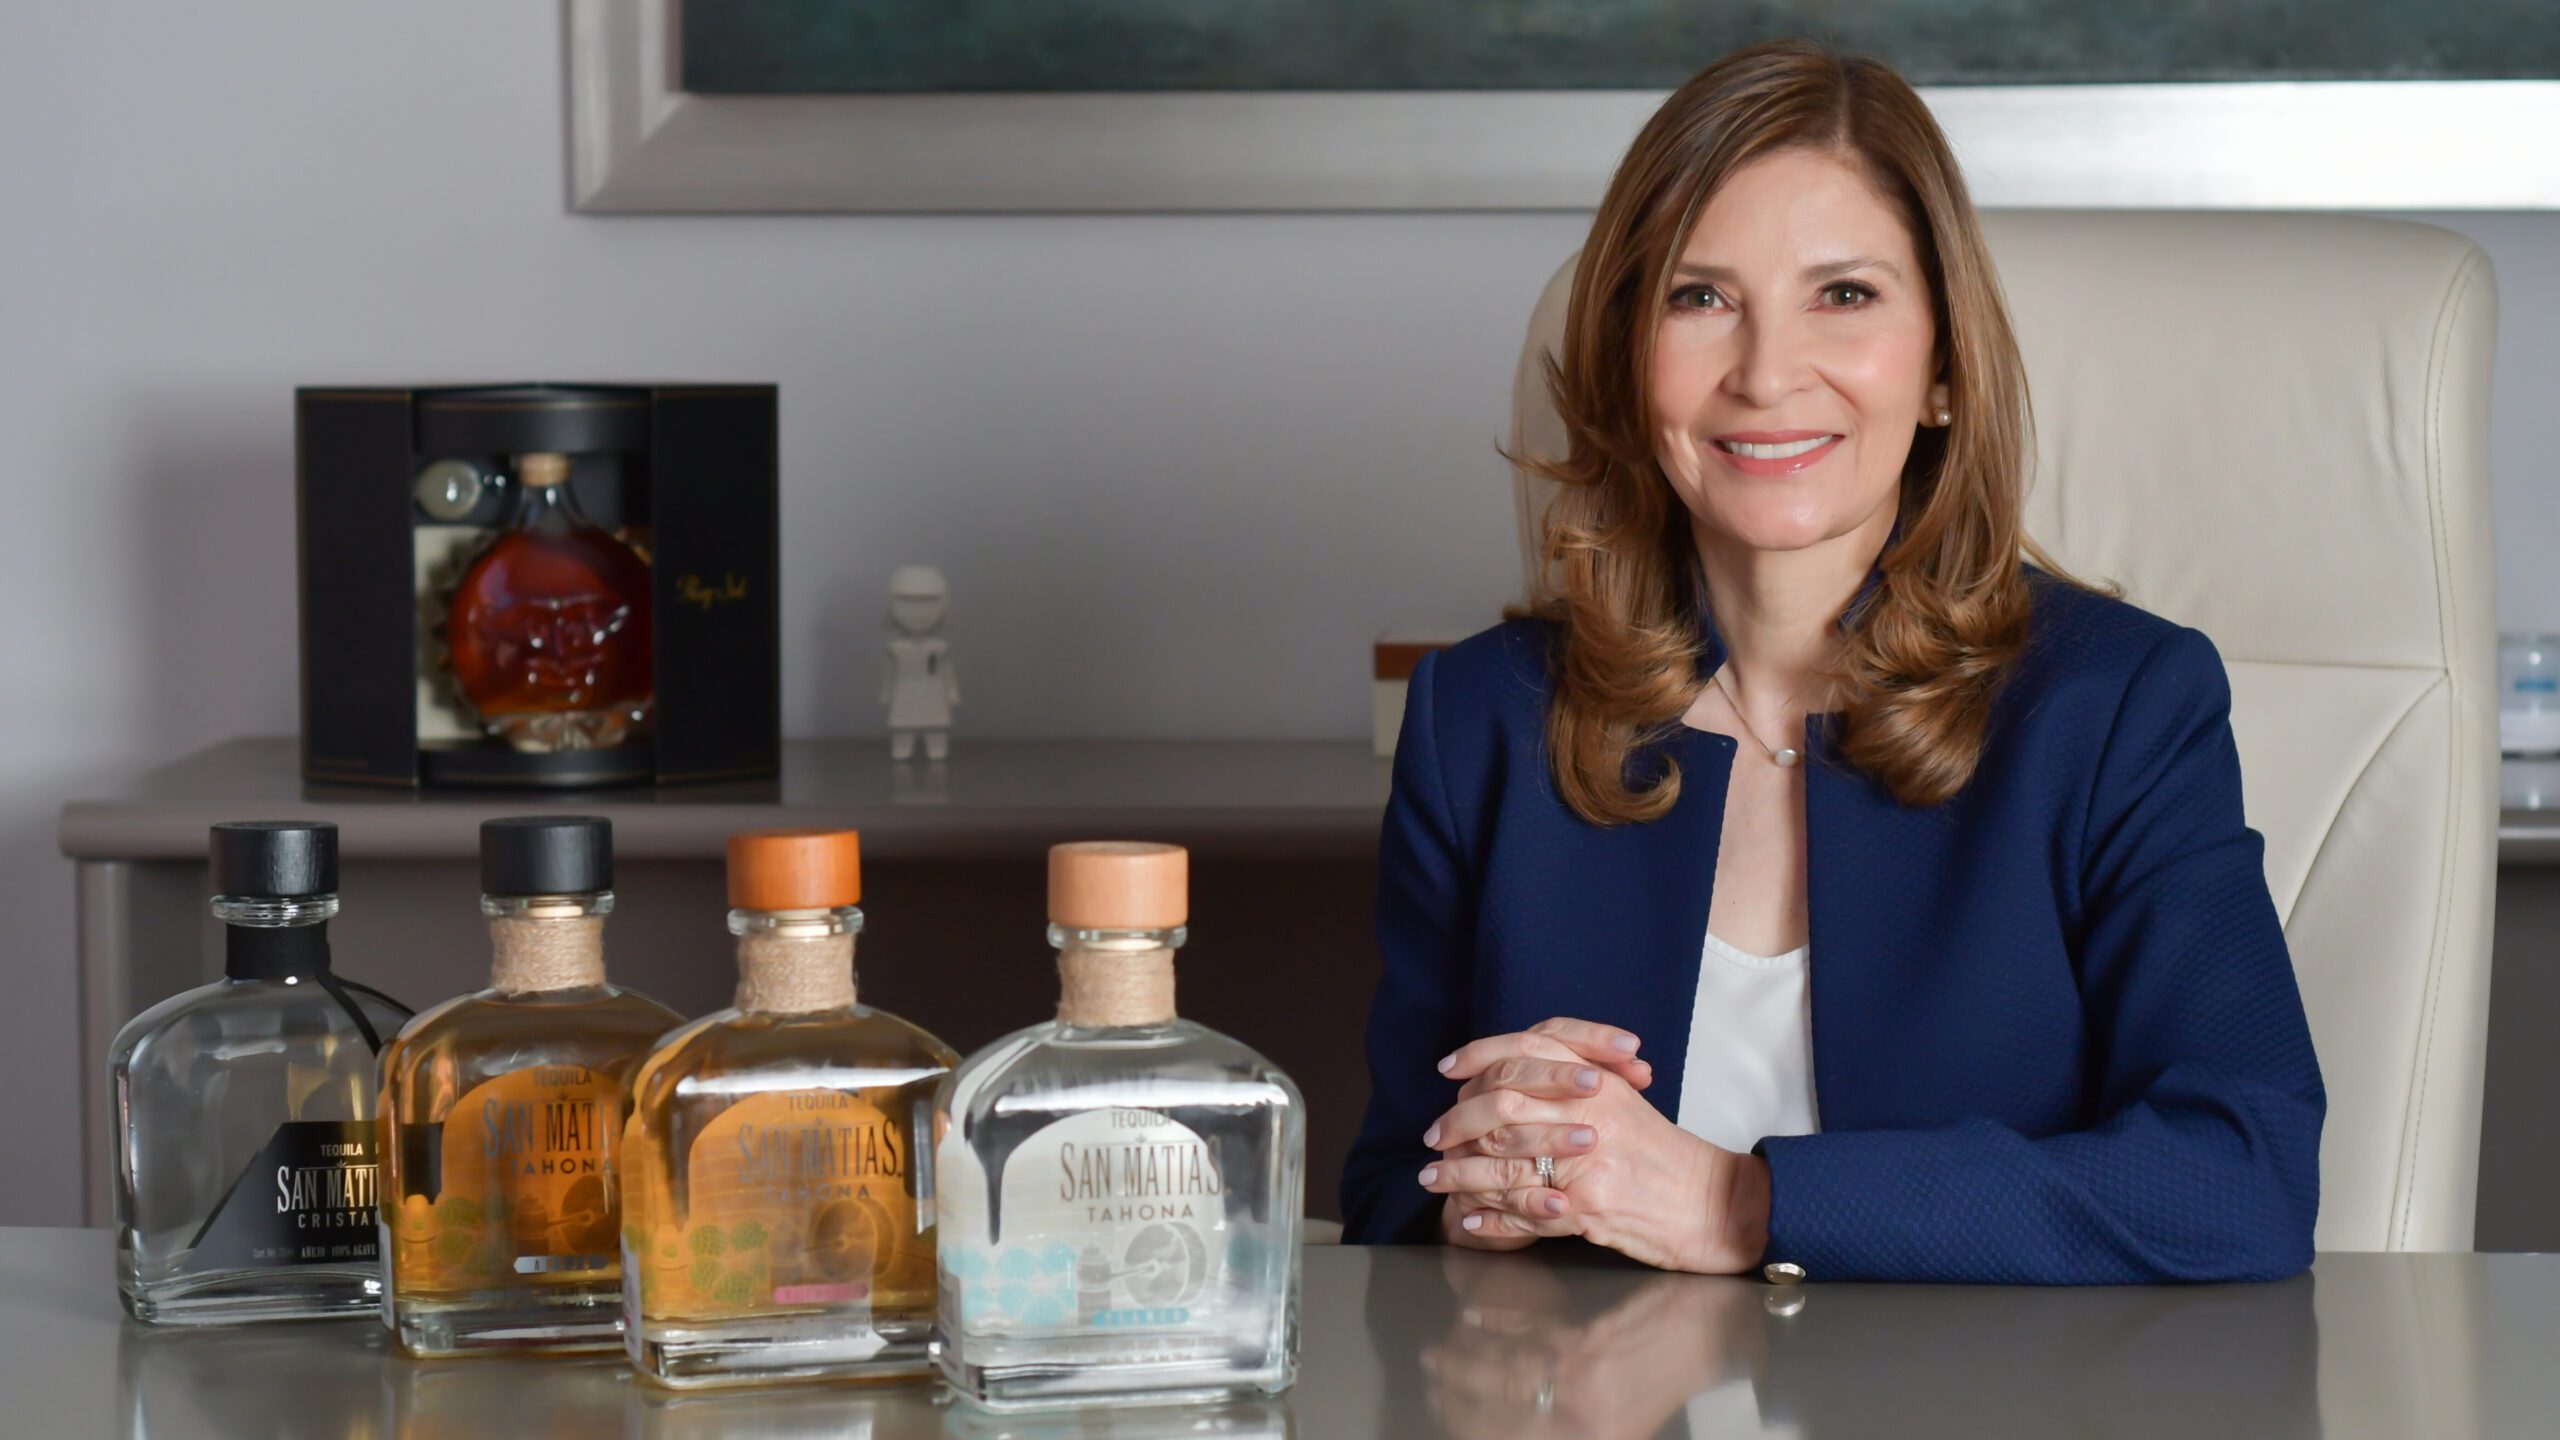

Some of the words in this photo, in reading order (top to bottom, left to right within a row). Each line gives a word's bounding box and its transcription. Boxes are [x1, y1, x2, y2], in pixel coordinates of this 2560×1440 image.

[533, 1070, 592, 1088] TEQUILA
[788, 1092, 848, 1111] TEQUILA
[484, 1097, 534, 1157] SAN
[1111, 1109, 1171, 1129] TEQUILA
[321, 1143, 363, 1156] TEQUILA
[738, 1121, 790, 1184] SAN
[1060, 1142, 1111, 1202] SAN
[276, 1165, 317, 1213] SAN
[766, 1182, 871, 1204] TAHONA
[1087, 1203, 1195, 1222] TAHONA
